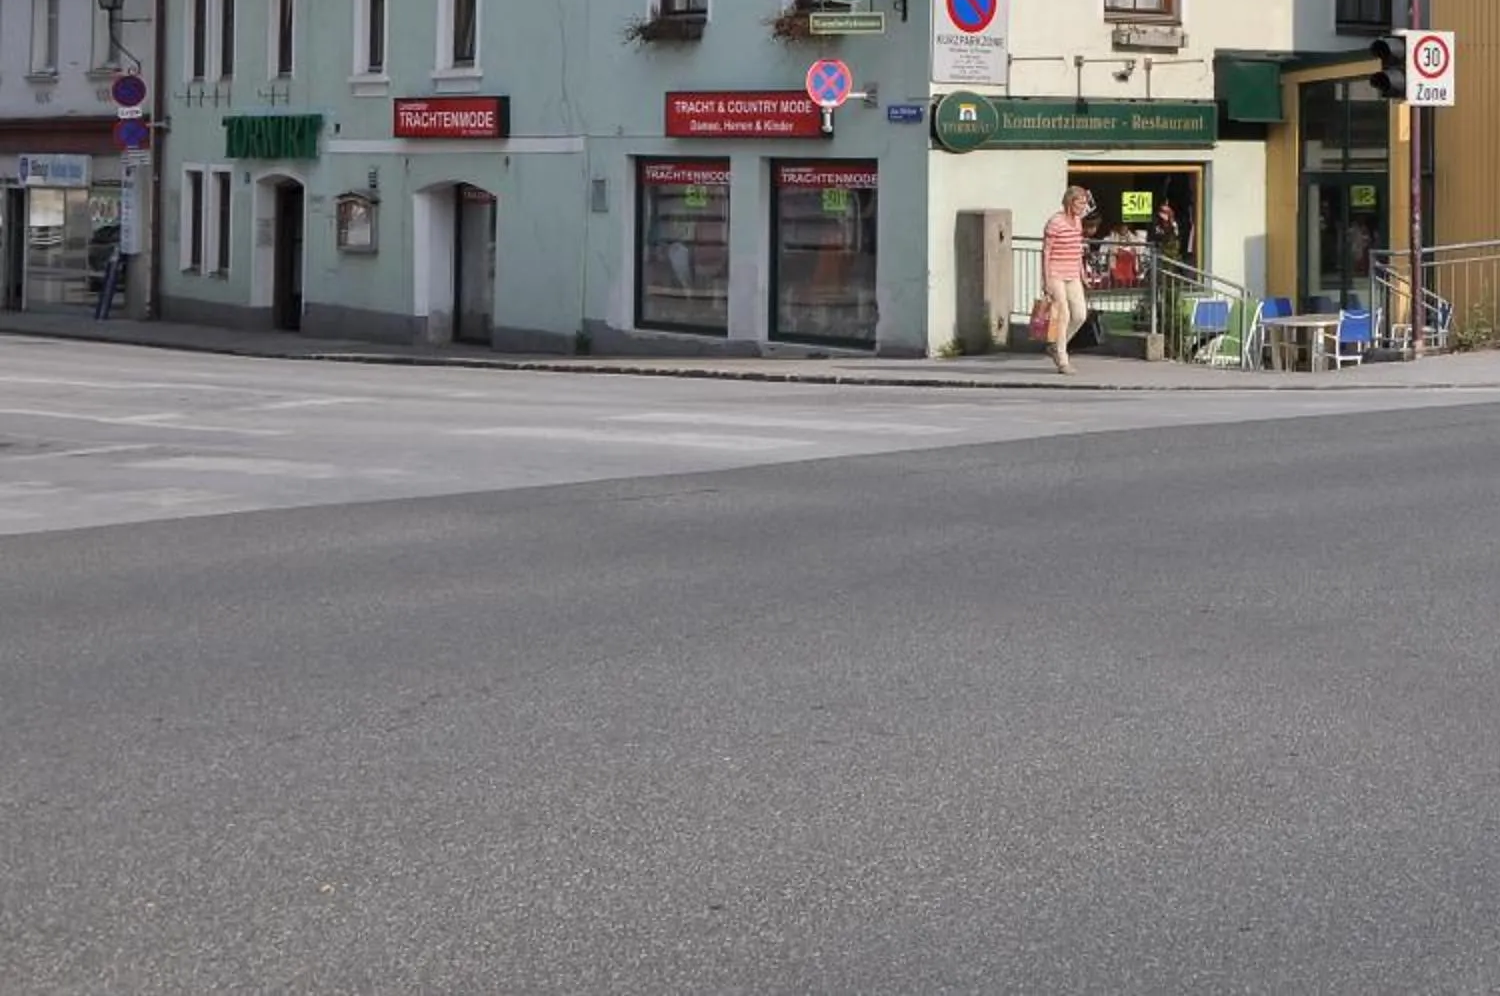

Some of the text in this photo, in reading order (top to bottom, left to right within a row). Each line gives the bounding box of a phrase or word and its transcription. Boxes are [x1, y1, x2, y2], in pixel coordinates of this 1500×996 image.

[1423, 47, 1441, 67] 30
[1415, 84, 1447, 101] Zone
[674, 99, 812, 113] TRACHT & COUNTRY MODE
[399, 111, 493, 128] TRACHTENMODE
[764, 120, 793, 131] Kinder
[1003, 112, 1116, 130] Komfortzimmer
[1132, 115, 1204, 131] Restaurant
